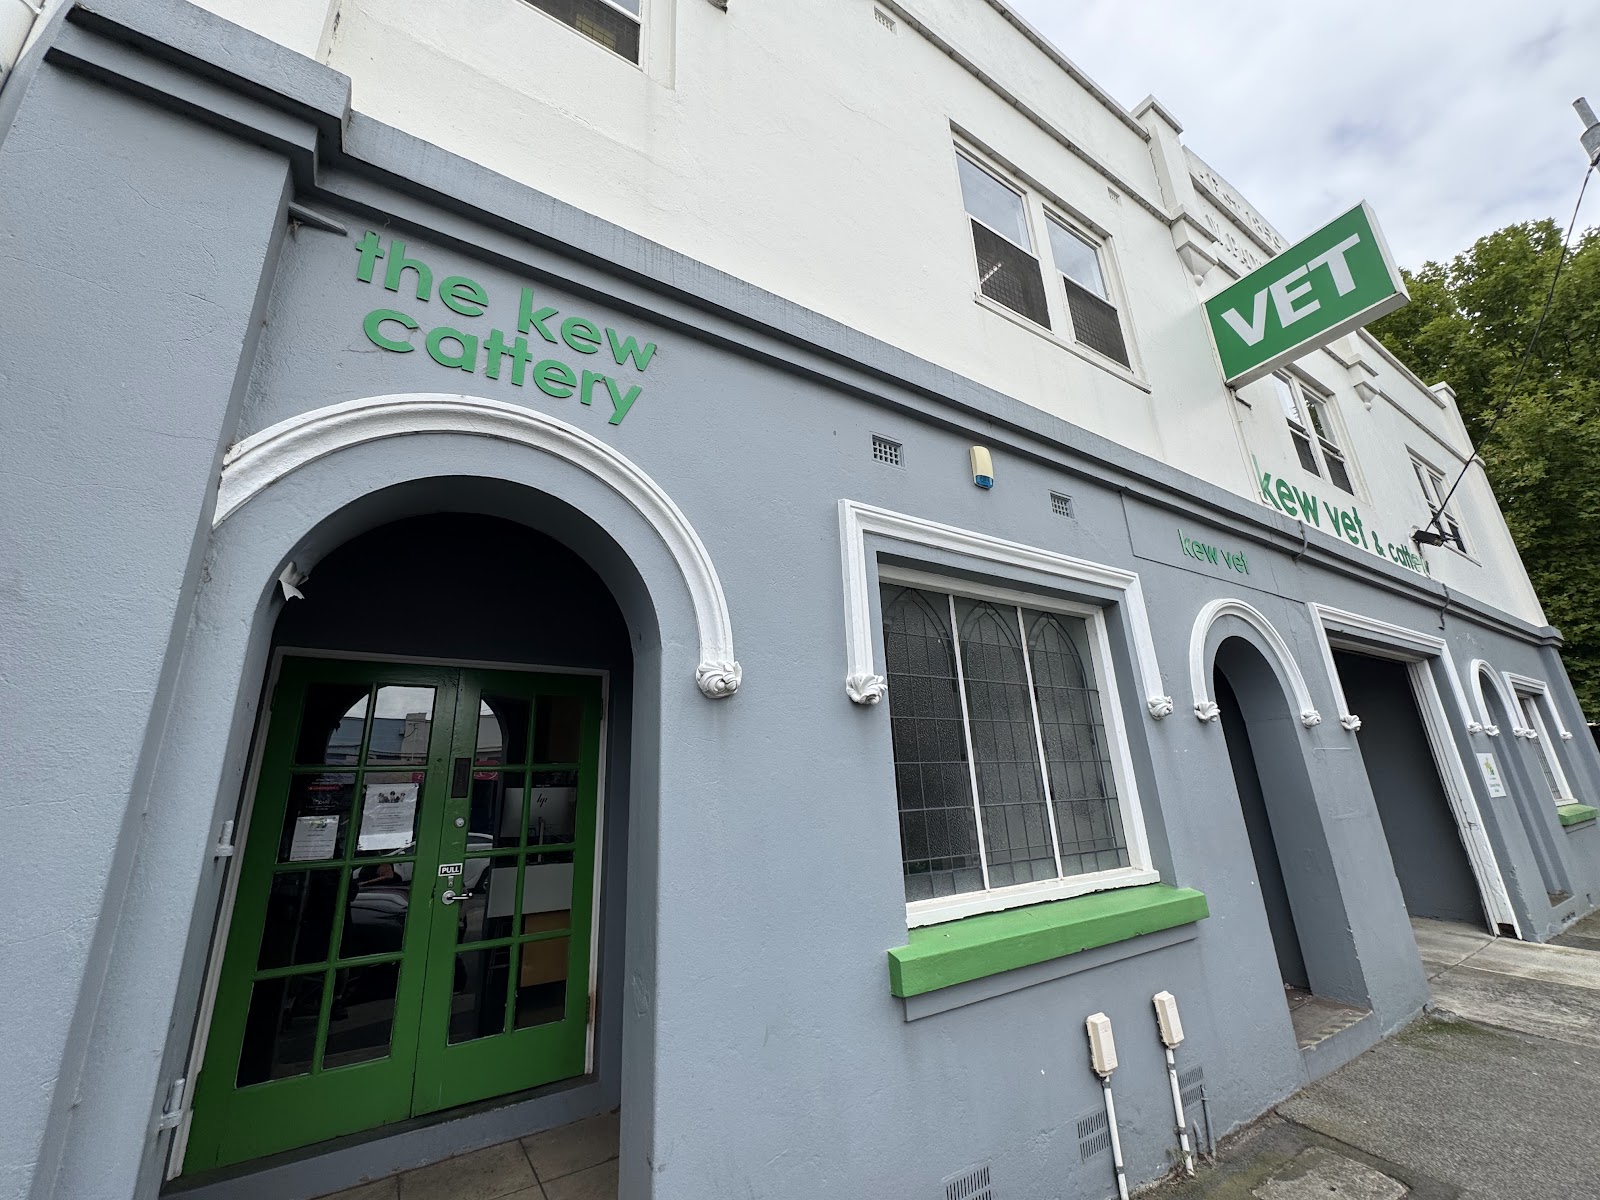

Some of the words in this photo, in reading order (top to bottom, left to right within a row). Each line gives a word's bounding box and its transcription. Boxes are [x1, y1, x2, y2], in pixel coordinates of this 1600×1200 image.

[355, 230, 489, 317] the
[517, 287, 657, 371] kew
[1220, 232, 1361, 347] VET
[363, 308, 642, 425] cattery
[1177, 528, 1219, 565] kew
[1221, 547, 1250, 575] vet
[1252, 454, 1319, 528] kew
[1323, 501, 1368, 550] vet
[1371, 530, 1386, 558] &
[441, 866, 460, 874] PULL
